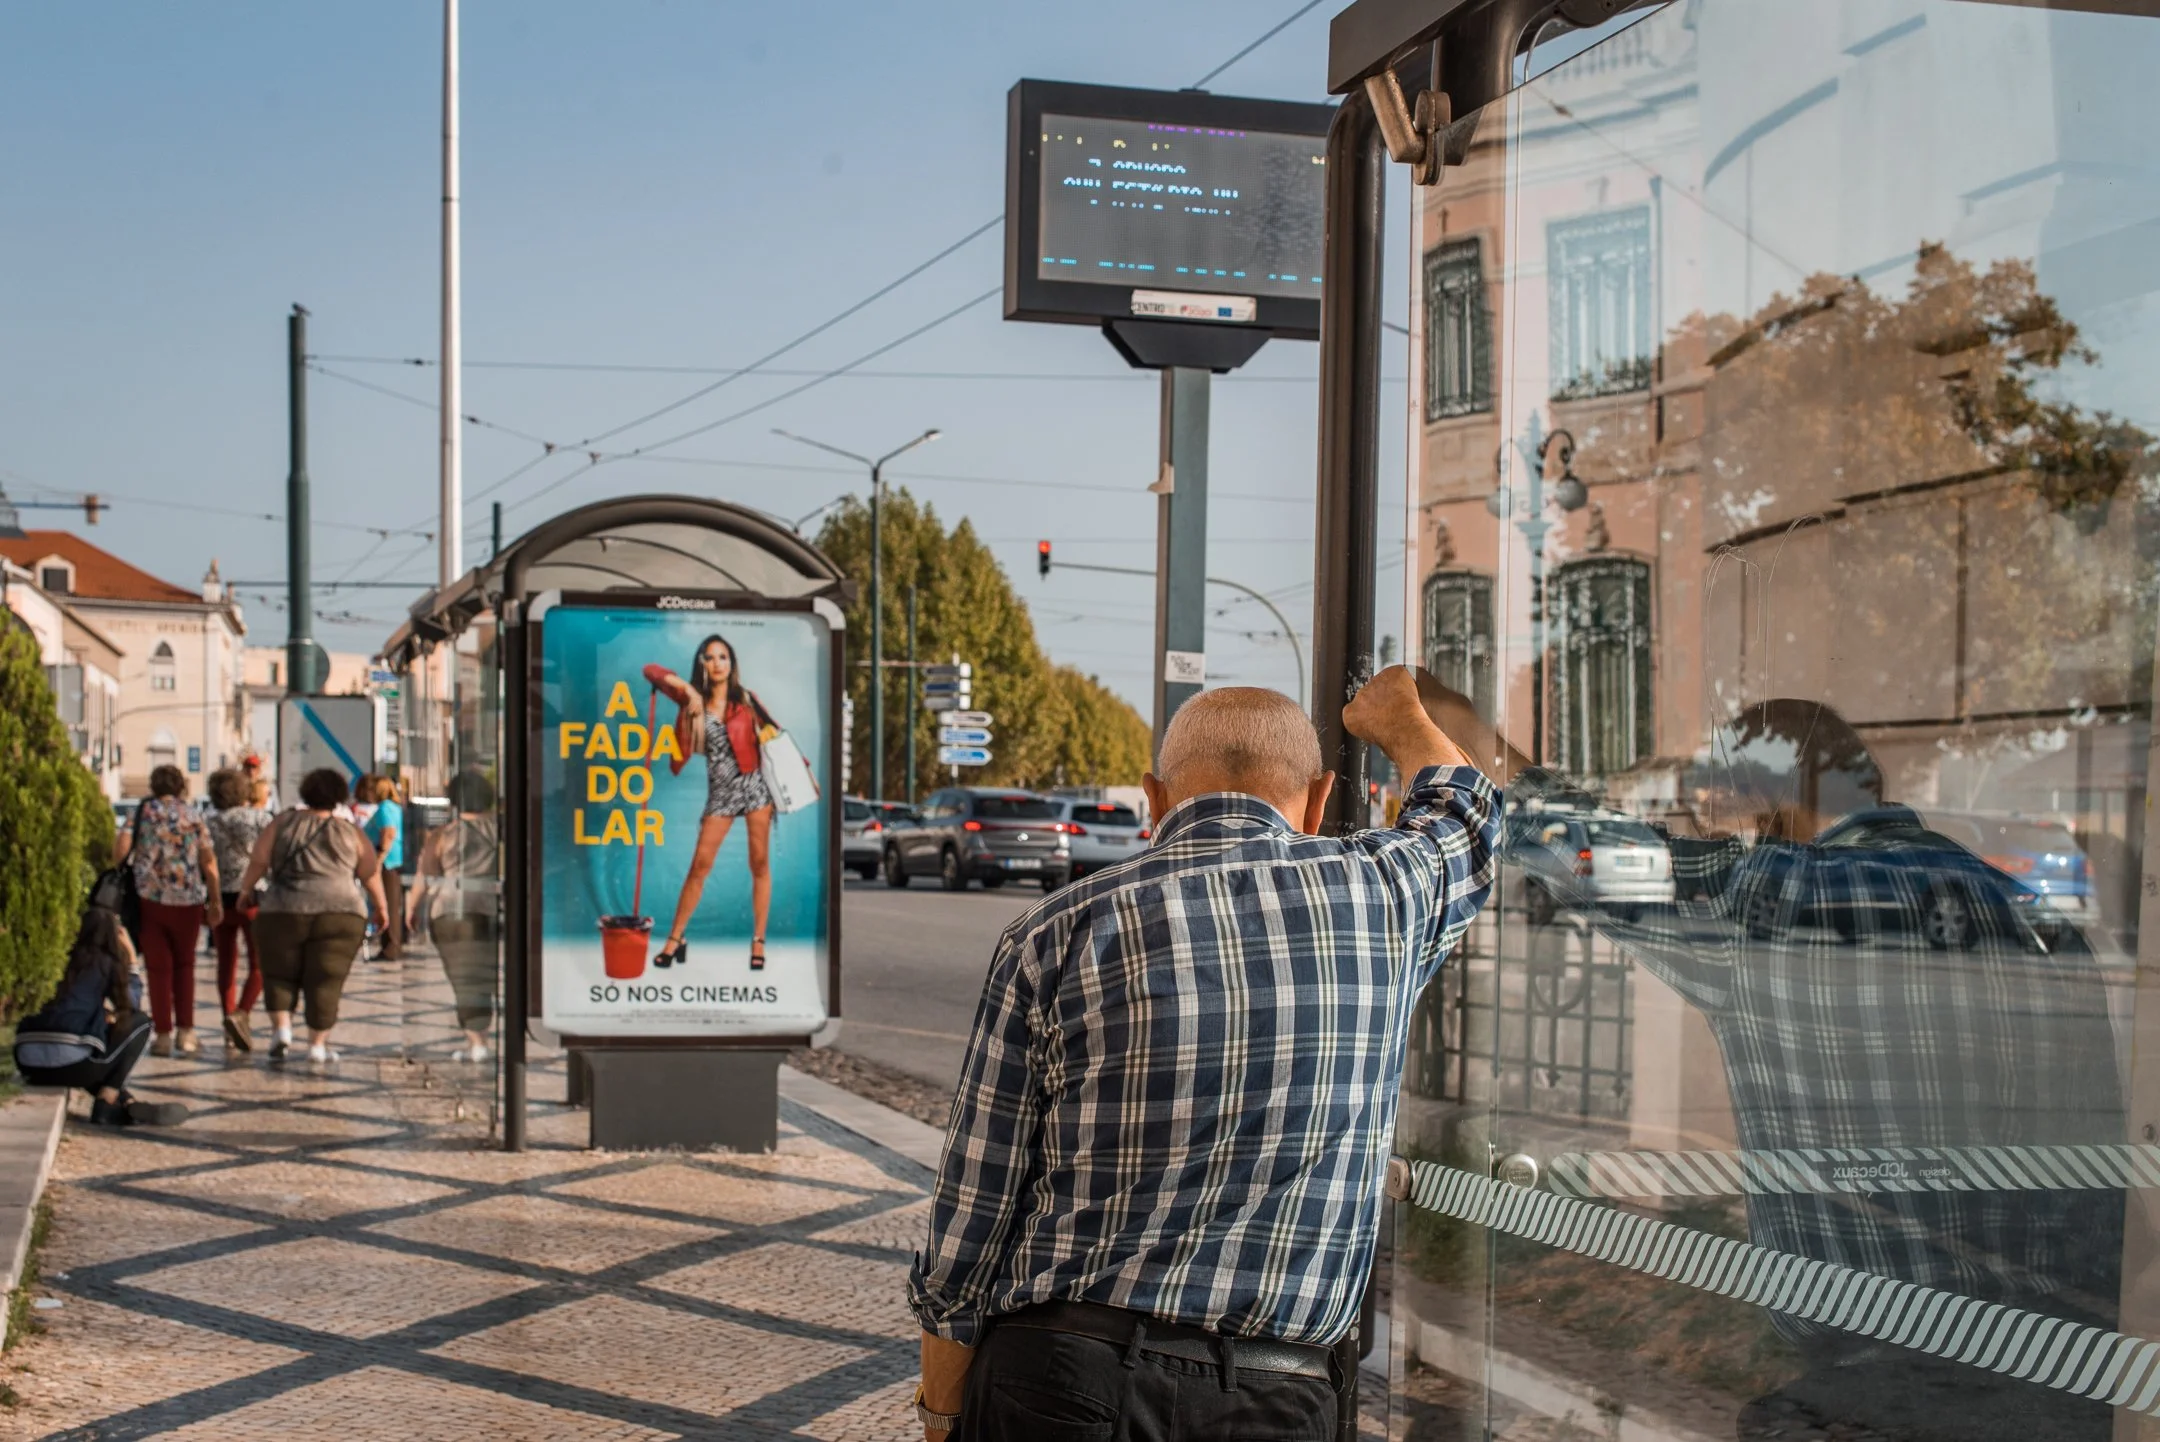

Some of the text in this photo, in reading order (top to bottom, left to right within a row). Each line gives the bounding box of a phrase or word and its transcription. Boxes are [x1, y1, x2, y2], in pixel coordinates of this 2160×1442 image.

[656, 595, 716, 609] JCDecaux
[604, 680, 638, 718] A
[559, 722, 684, 761] FADA
[587, 765, 654, 804] DO
[573, 808, 665, 846] LAR
[590, 981, 778, 1003] SÓ NOS CINEMAS
